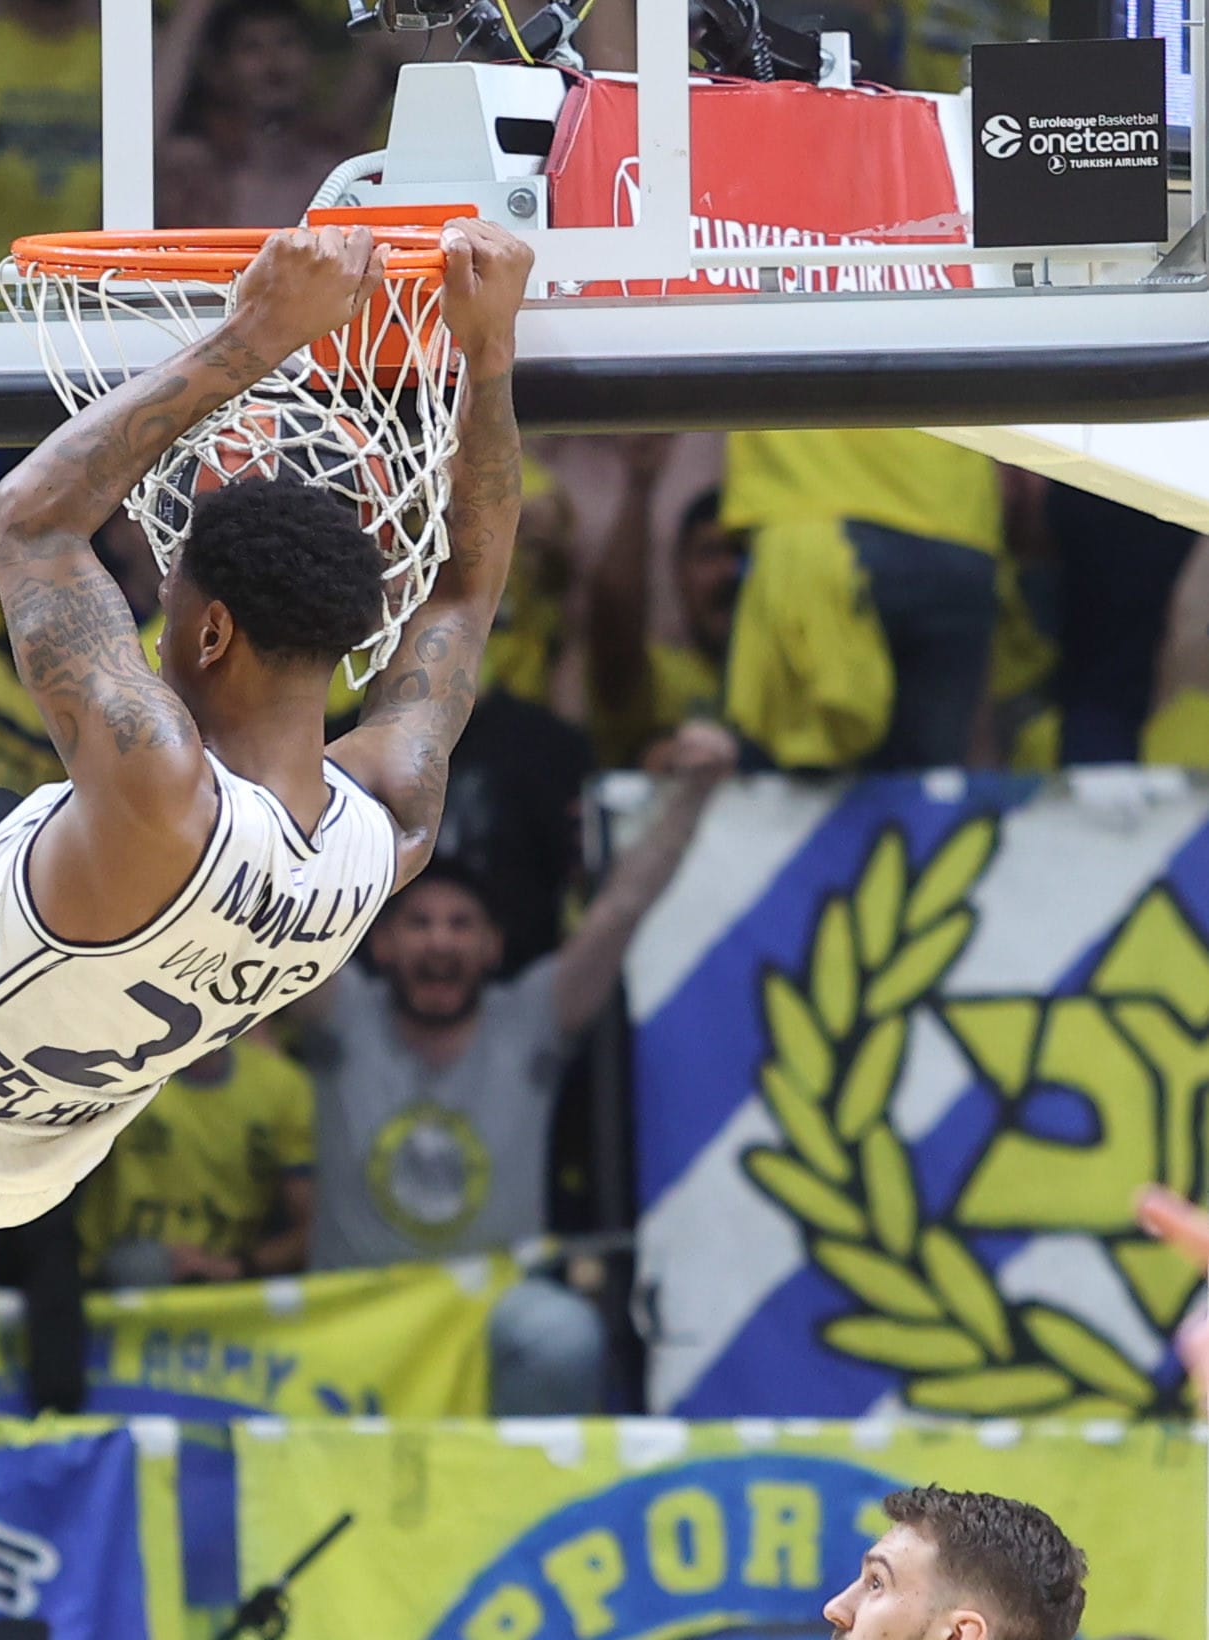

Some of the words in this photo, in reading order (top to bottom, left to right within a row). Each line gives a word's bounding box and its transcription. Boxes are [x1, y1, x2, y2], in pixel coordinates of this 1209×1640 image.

[1028, 116, 1097, 130] Euroleague
[1098, 113, 1158, 126] Basketball
[1029, 128, 1159, 154] oneteam
[1070, 159, 1112, 168] TURKISH
[1115, 157, 1158, 167] AIRLINES
